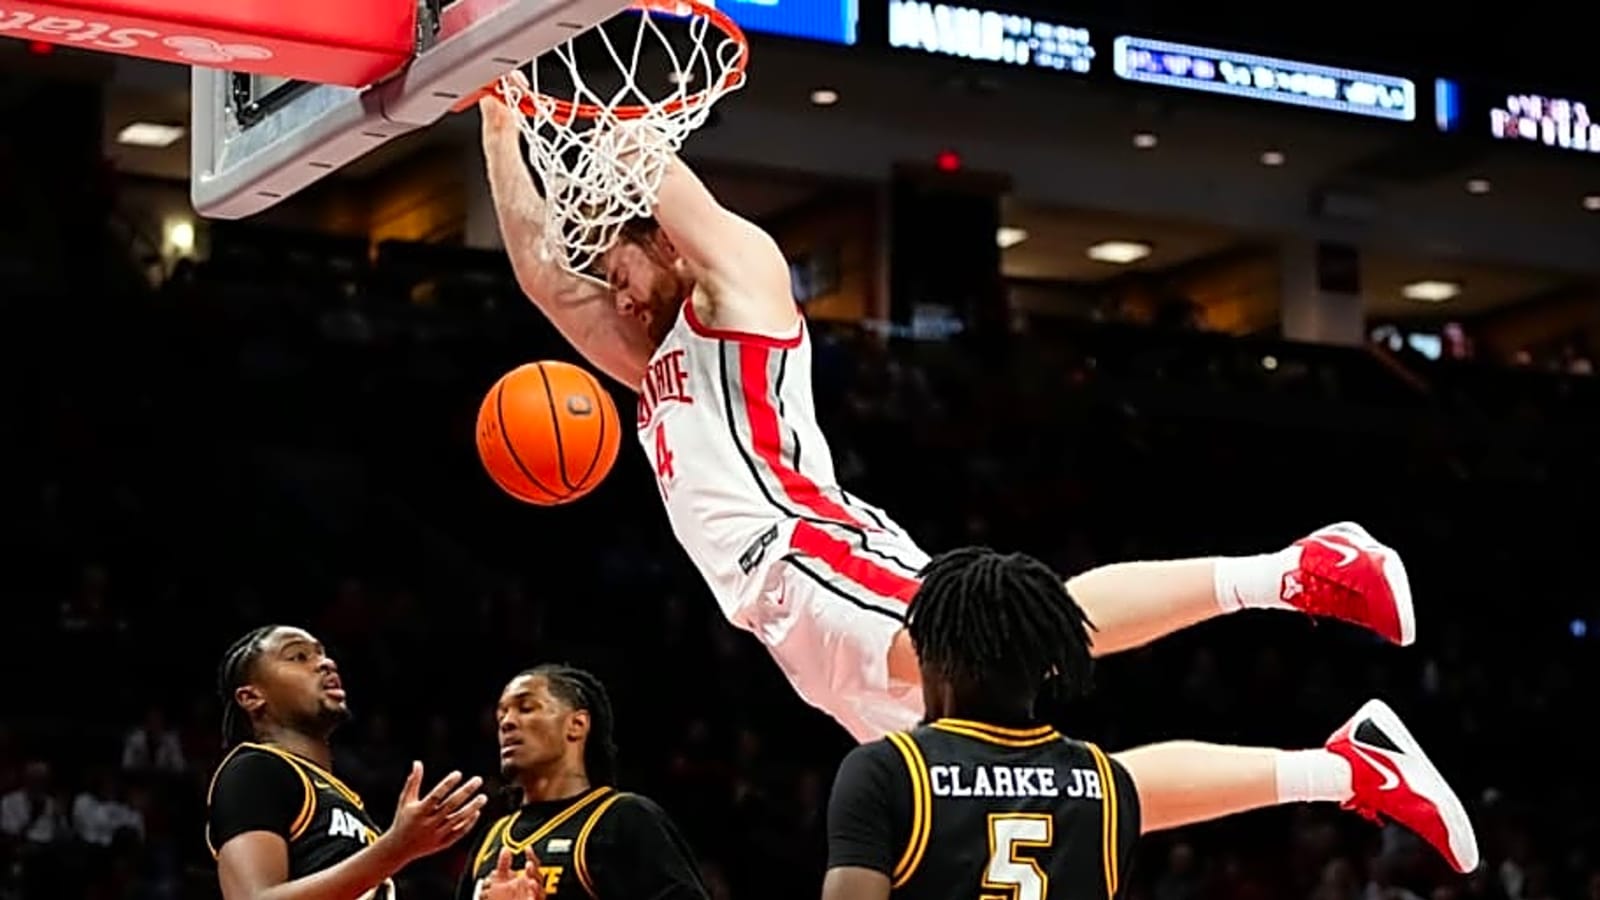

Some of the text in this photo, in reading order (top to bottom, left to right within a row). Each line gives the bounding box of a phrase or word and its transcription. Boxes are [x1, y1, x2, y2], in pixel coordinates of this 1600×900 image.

[0, 9, 160, 49] Stat
[930, 765, 1103, 800] CLARKE JR
[980, 813, 1053, 900] 5
